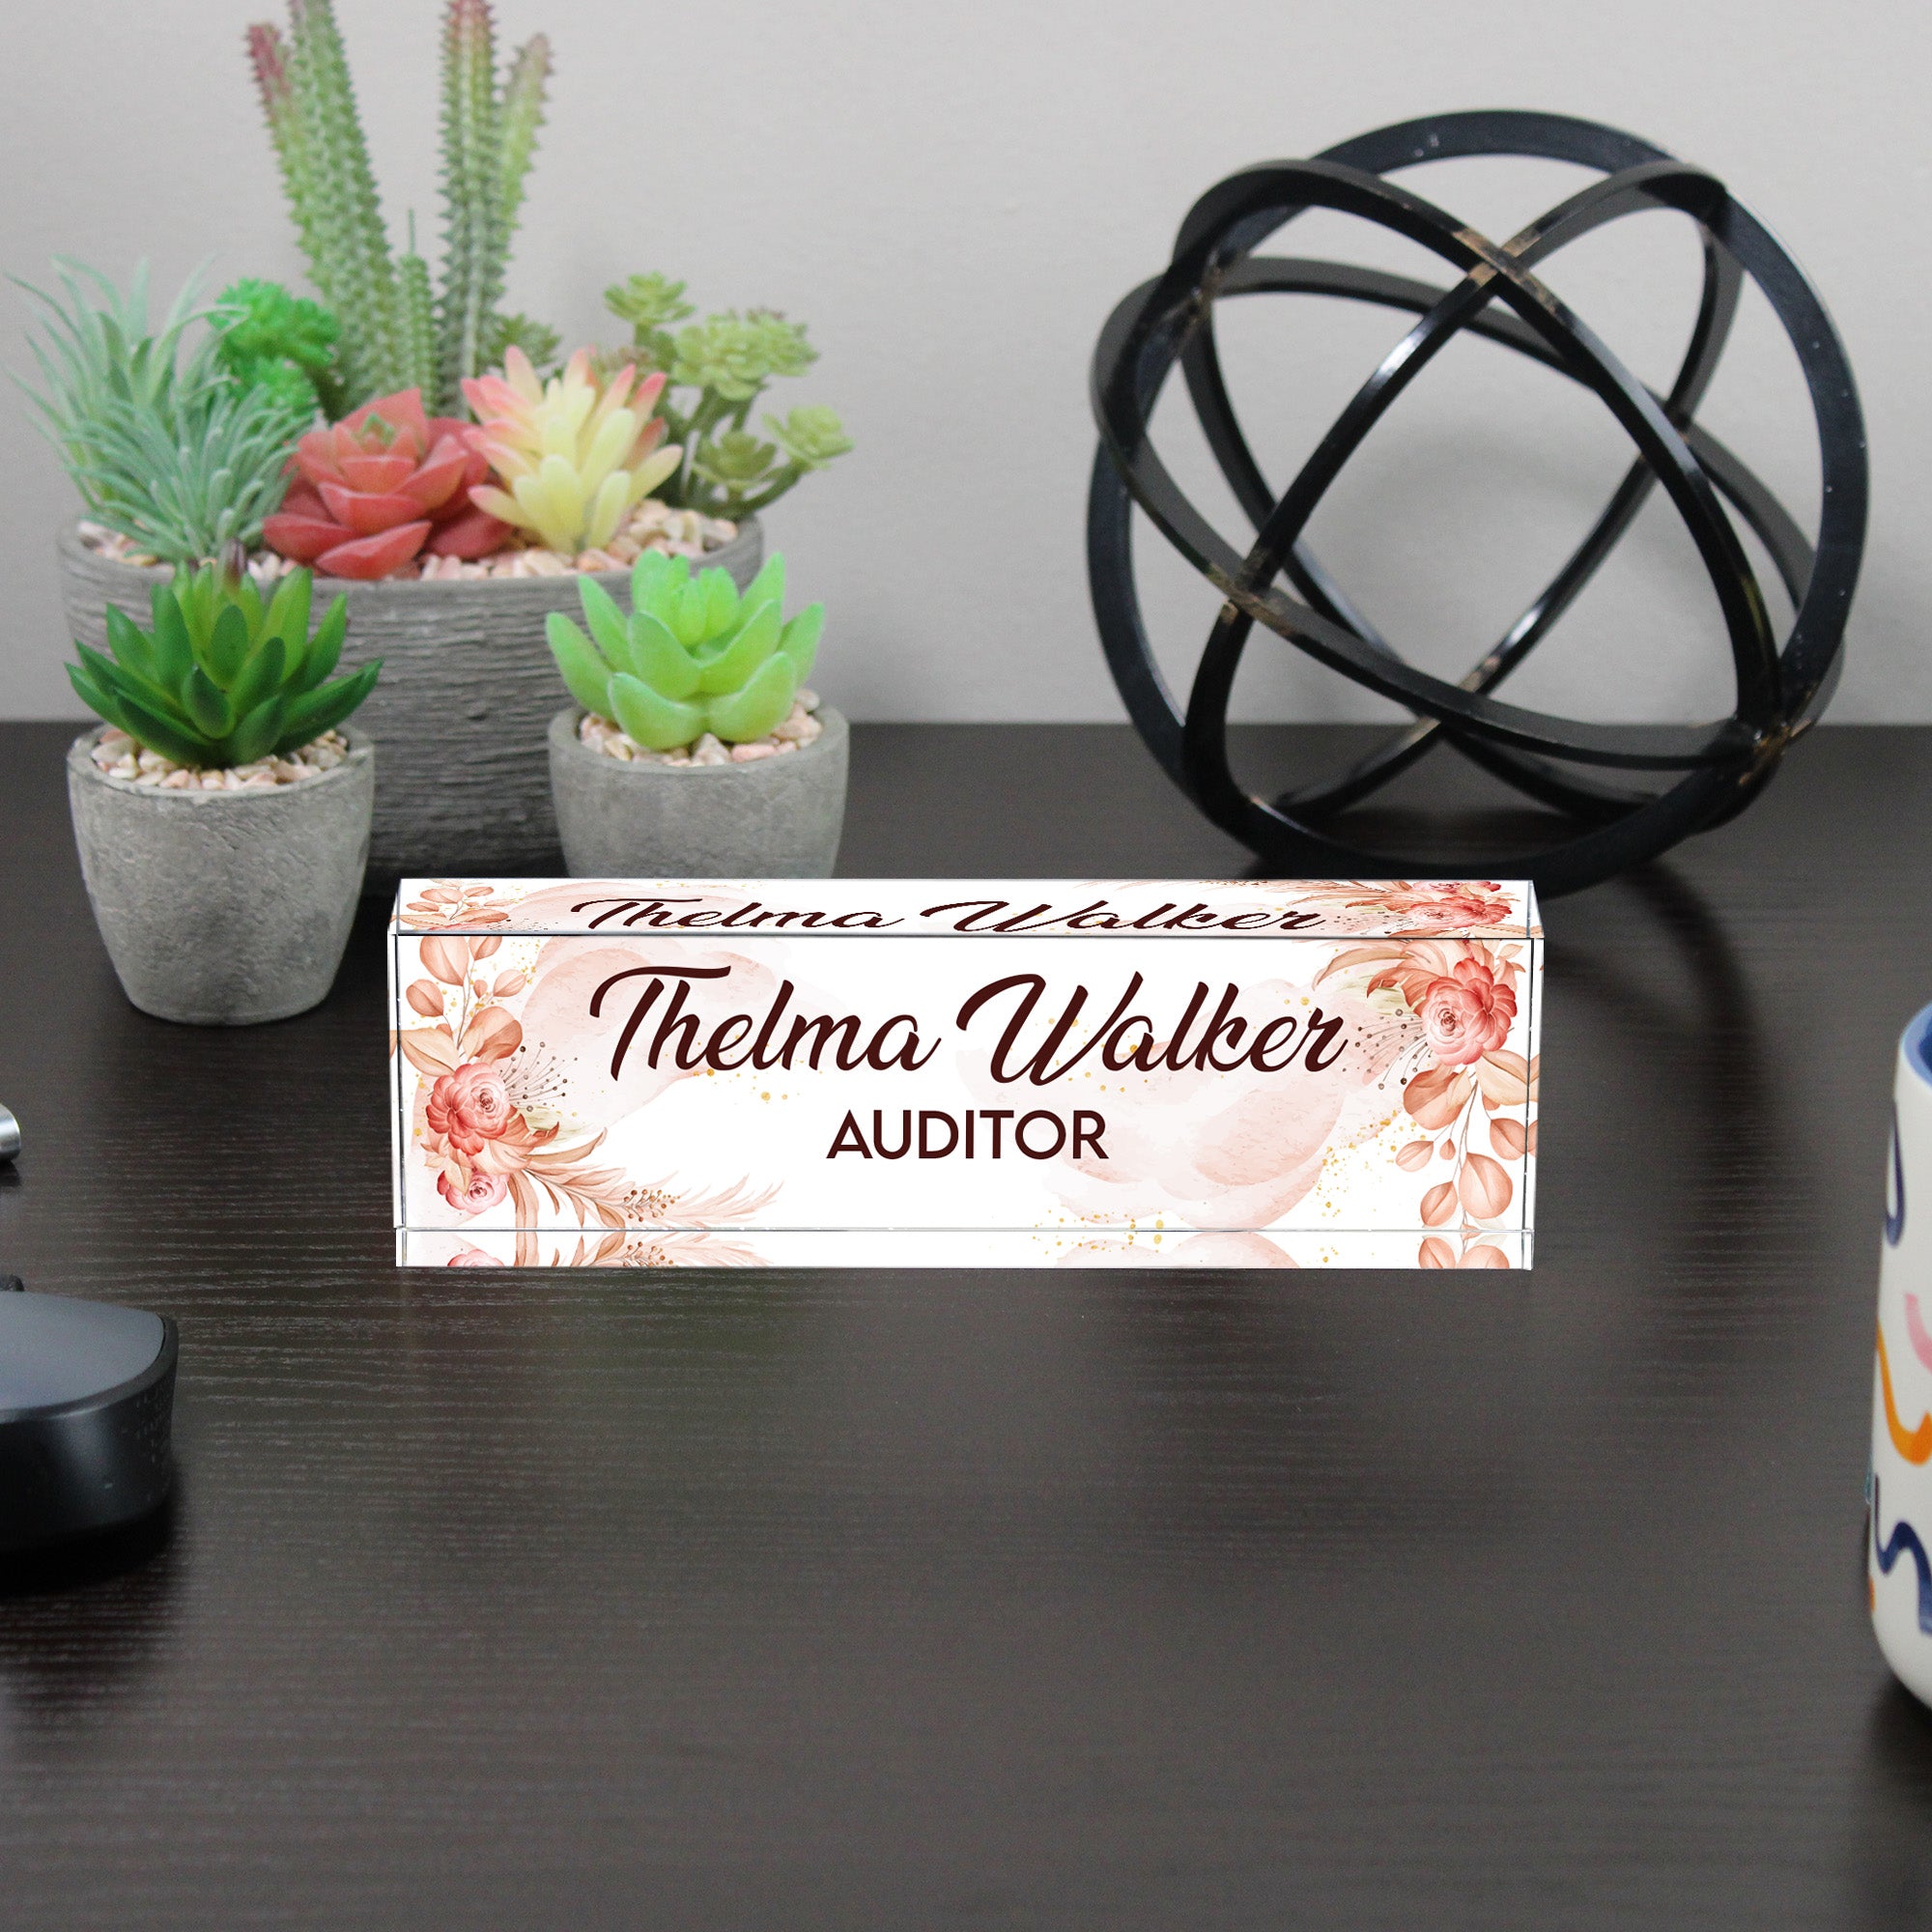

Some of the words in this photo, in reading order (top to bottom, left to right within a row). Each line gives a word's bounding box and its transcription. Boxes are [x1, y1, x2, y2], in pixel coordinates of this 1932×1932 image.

[571, 897, 904, 931] Thelma
[920, 899, 1326, 933] Walker
[590, 965, 941, 1082] Thelma
[956, 972, 1349, 1087] Walker
[827, 1109, 1110, 1160] AUDITOR
